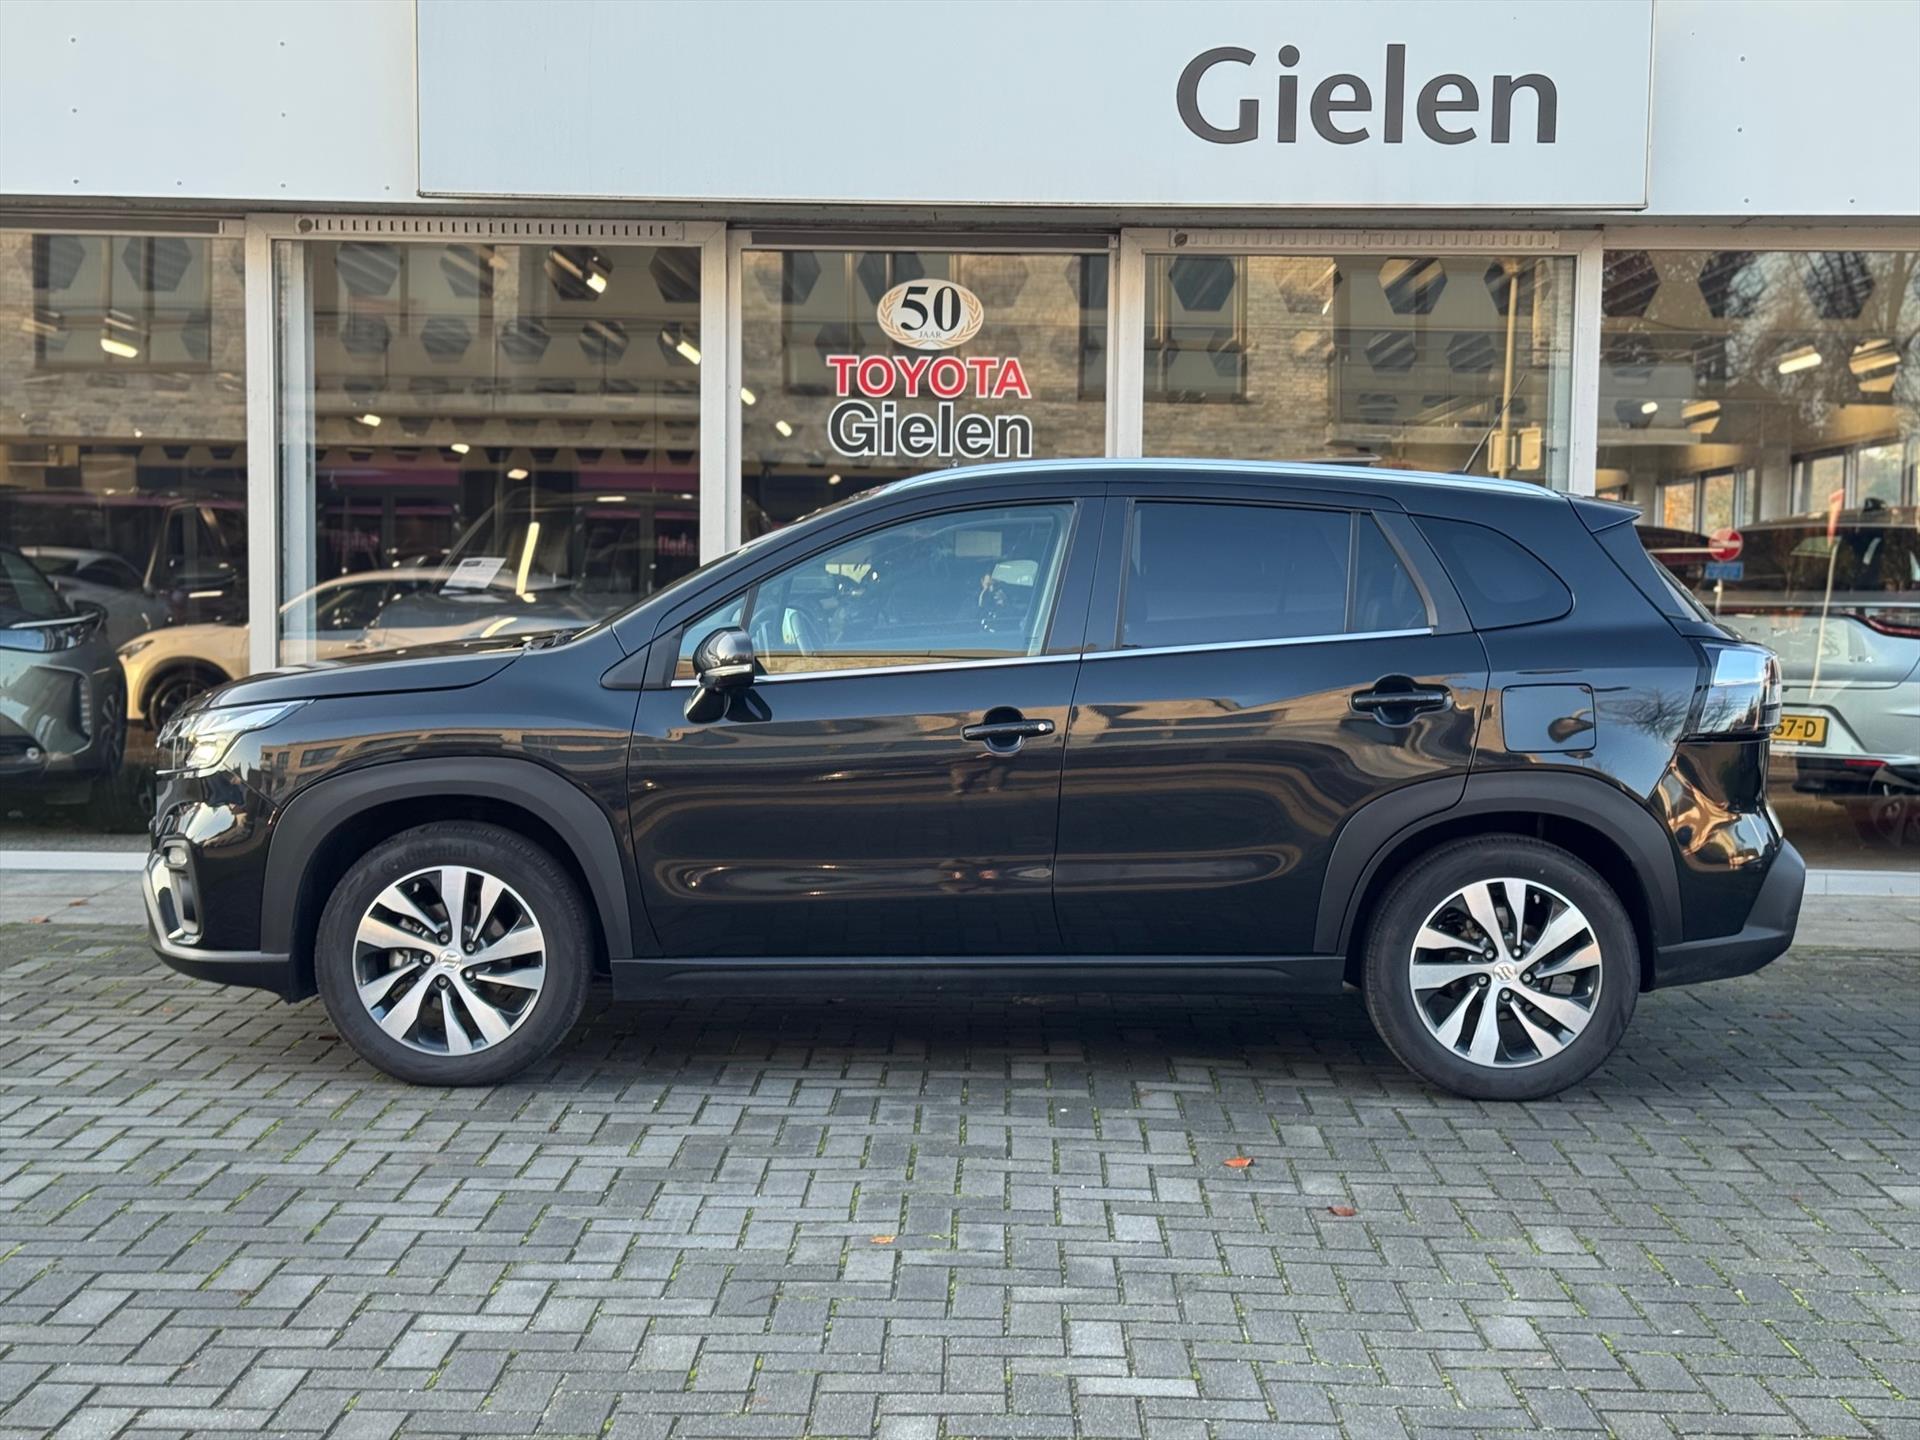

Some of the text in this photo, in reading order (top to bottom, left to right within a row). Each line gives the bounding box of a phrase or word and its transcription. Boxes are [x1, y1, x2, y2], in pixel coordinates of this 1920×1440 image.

[1176, 44, 1558, 144] Gielen
[900, 286, 961, 332] 50
[919, 330, 942, 339] JAAR
[827, 355, 1032, 399] TOYOTA
[828, 400, 1032, 458] Gielen
